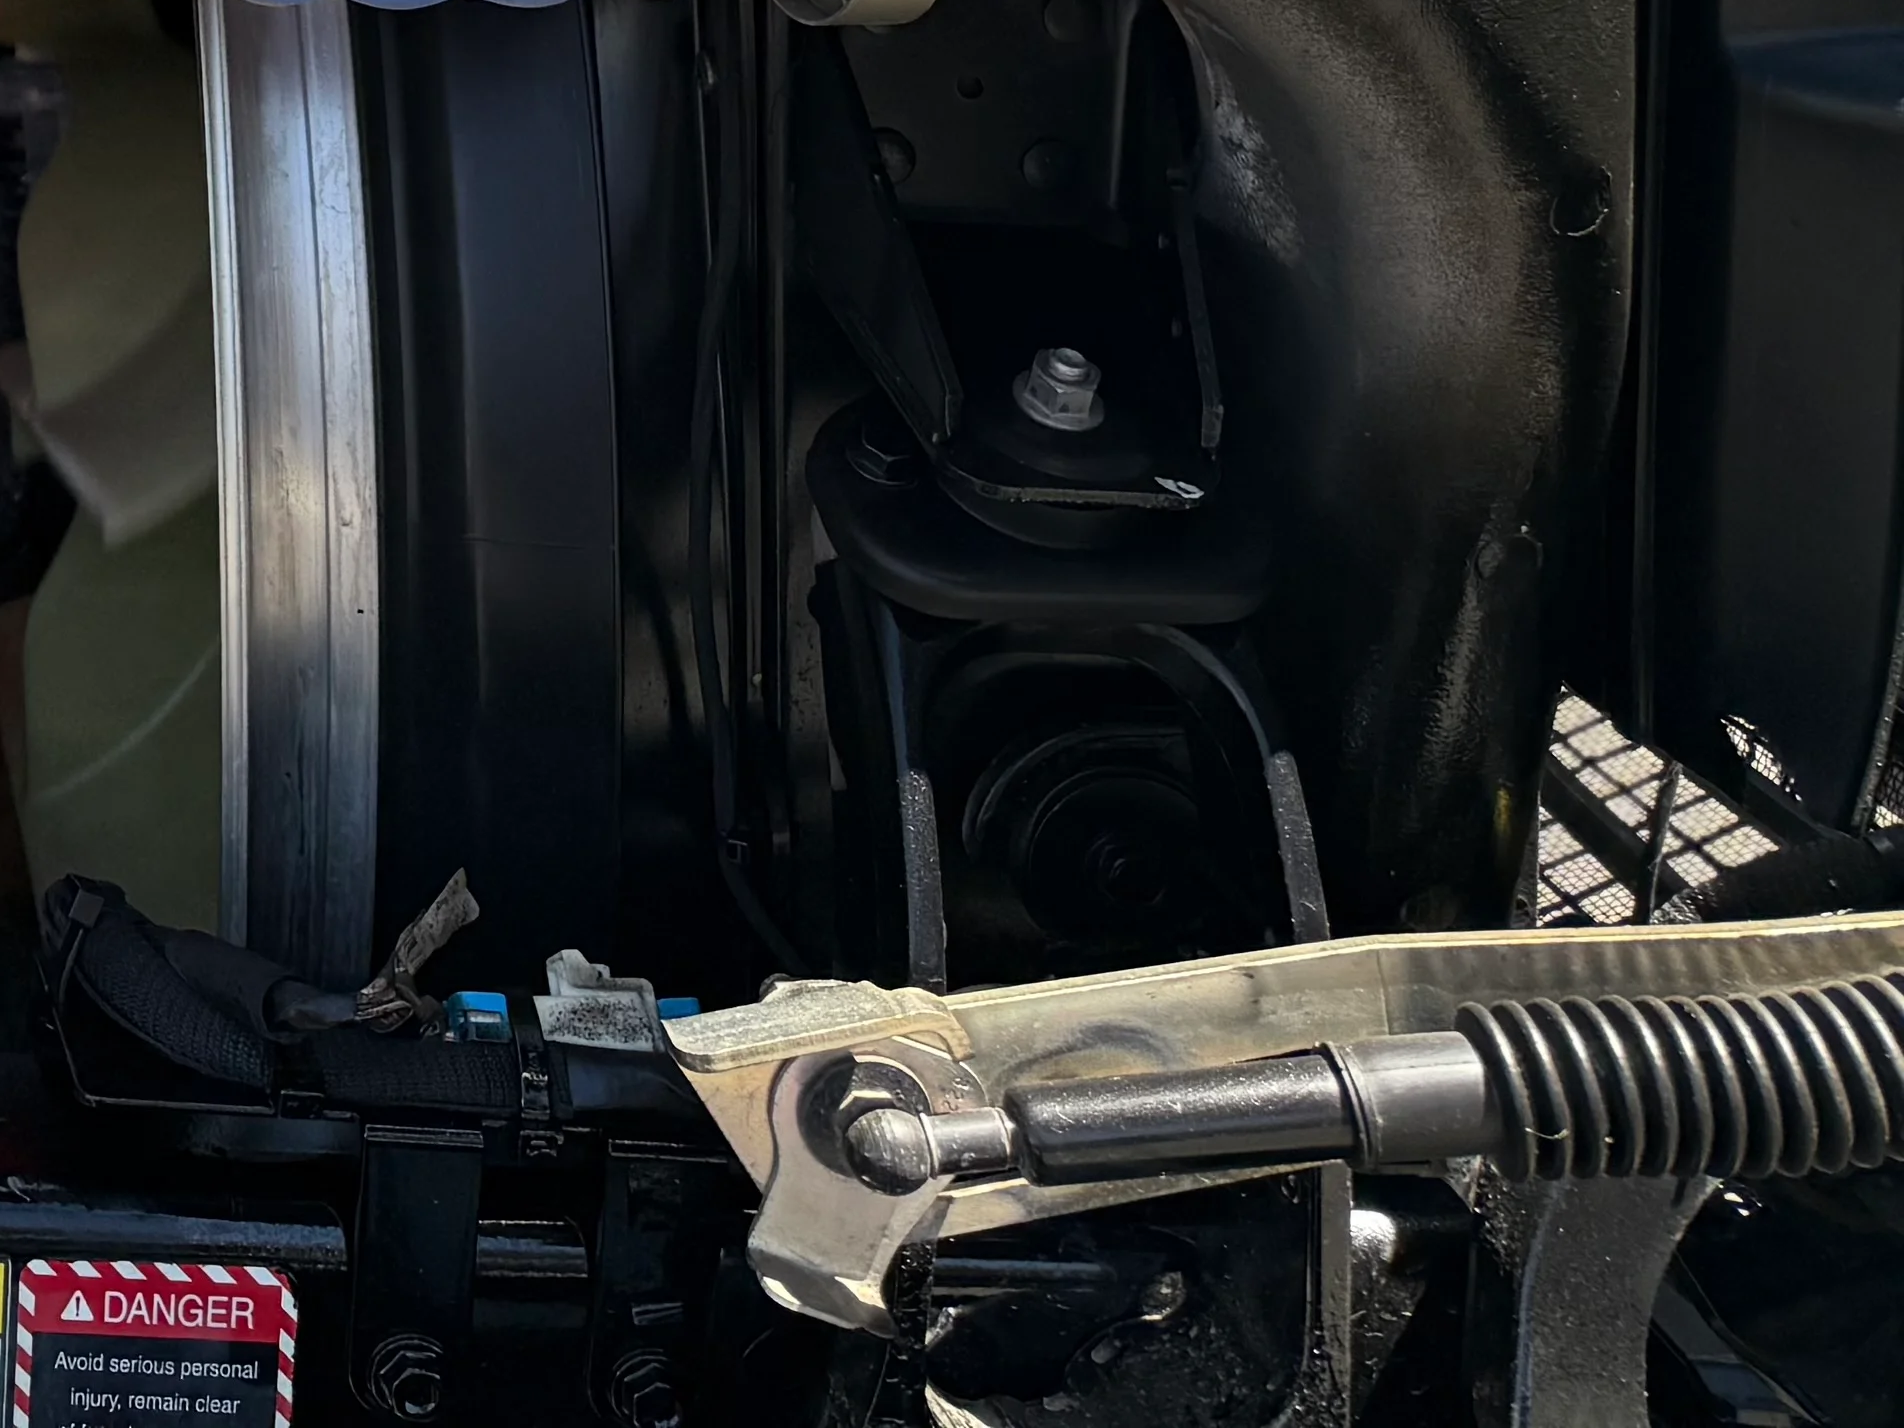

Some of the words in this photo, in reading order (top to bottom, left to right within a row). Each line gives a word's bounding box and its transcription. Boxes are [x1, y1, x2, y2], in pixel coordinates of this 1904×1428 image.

[103, 1290, 255, 1330] DANGER
[54, 1351, 104, 1372] Avoid
[109, 1355, 175, 1376] serious
[180, 1361, 259, 1380] personal
[70, 1387, 122, 1412] injury,
[128, 1391, 190, 1413] remain
[195, 1395, 241, 1414] clear
